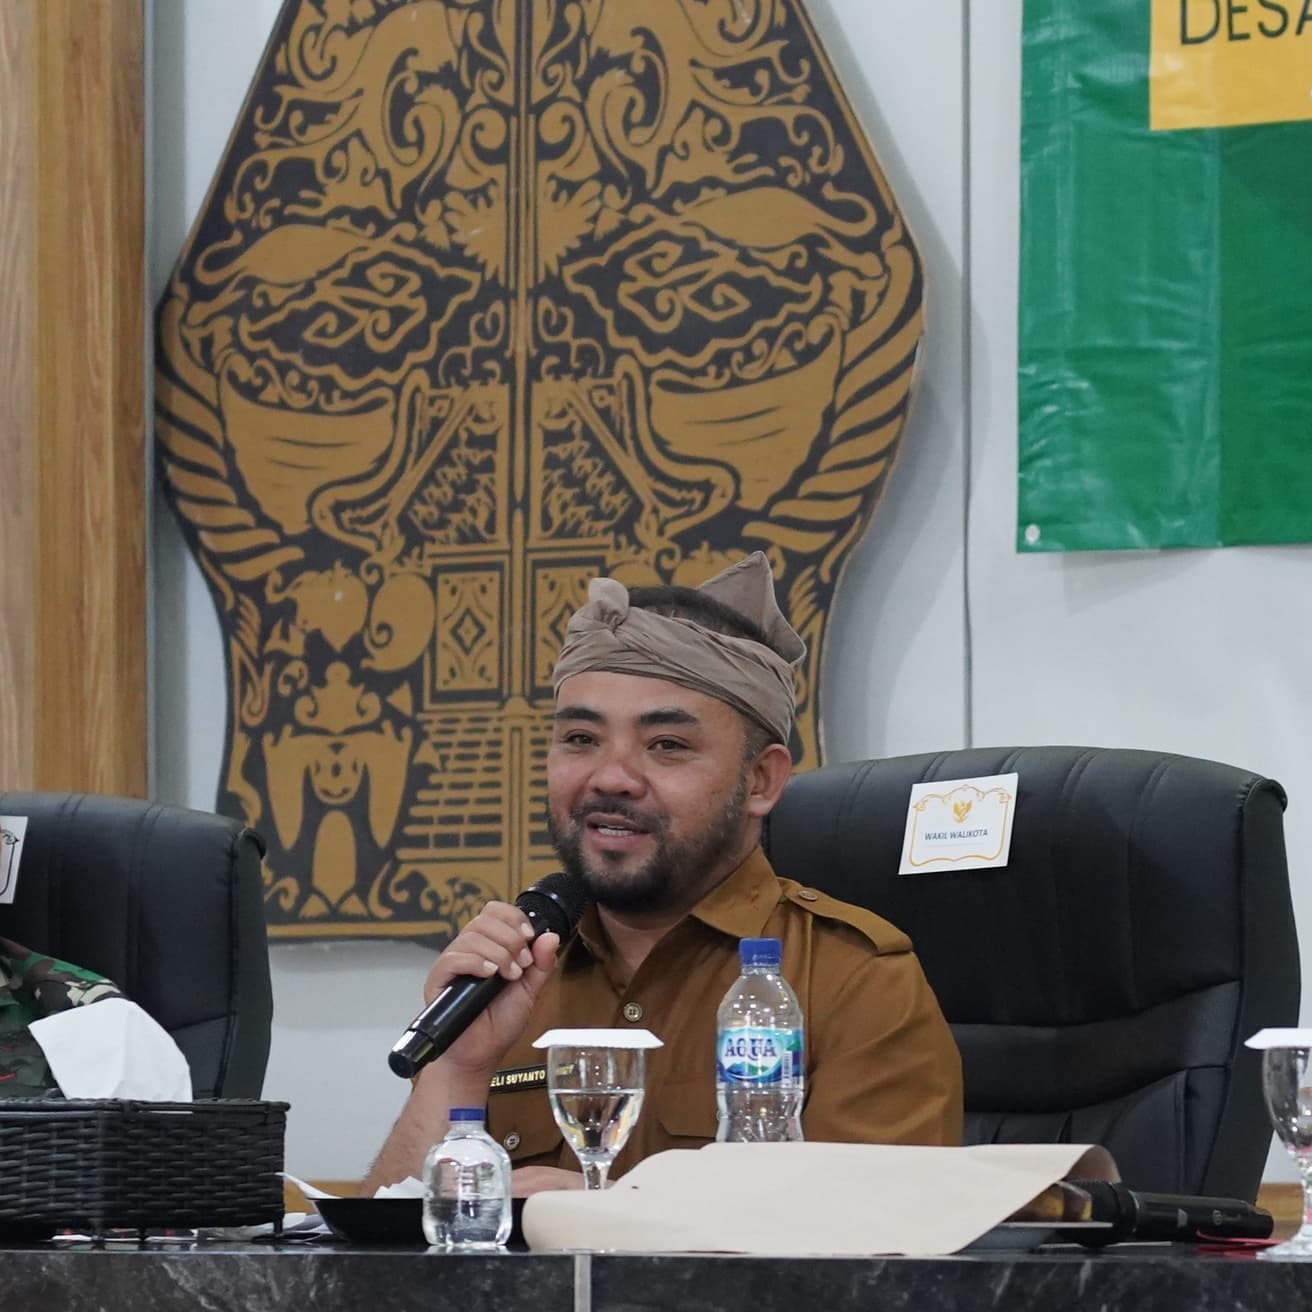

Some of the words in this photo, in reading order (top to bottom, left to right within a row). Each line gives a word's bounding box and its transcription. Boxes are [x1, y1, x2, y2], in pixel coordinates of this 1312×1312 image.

[924, 832, 948, 841] WAKIL
[949, 829, 989, 839] WALIKOTA
[725, 1038, 777, 1061] AQUA
[506, 1069, 546, 1085] SUYANTO
